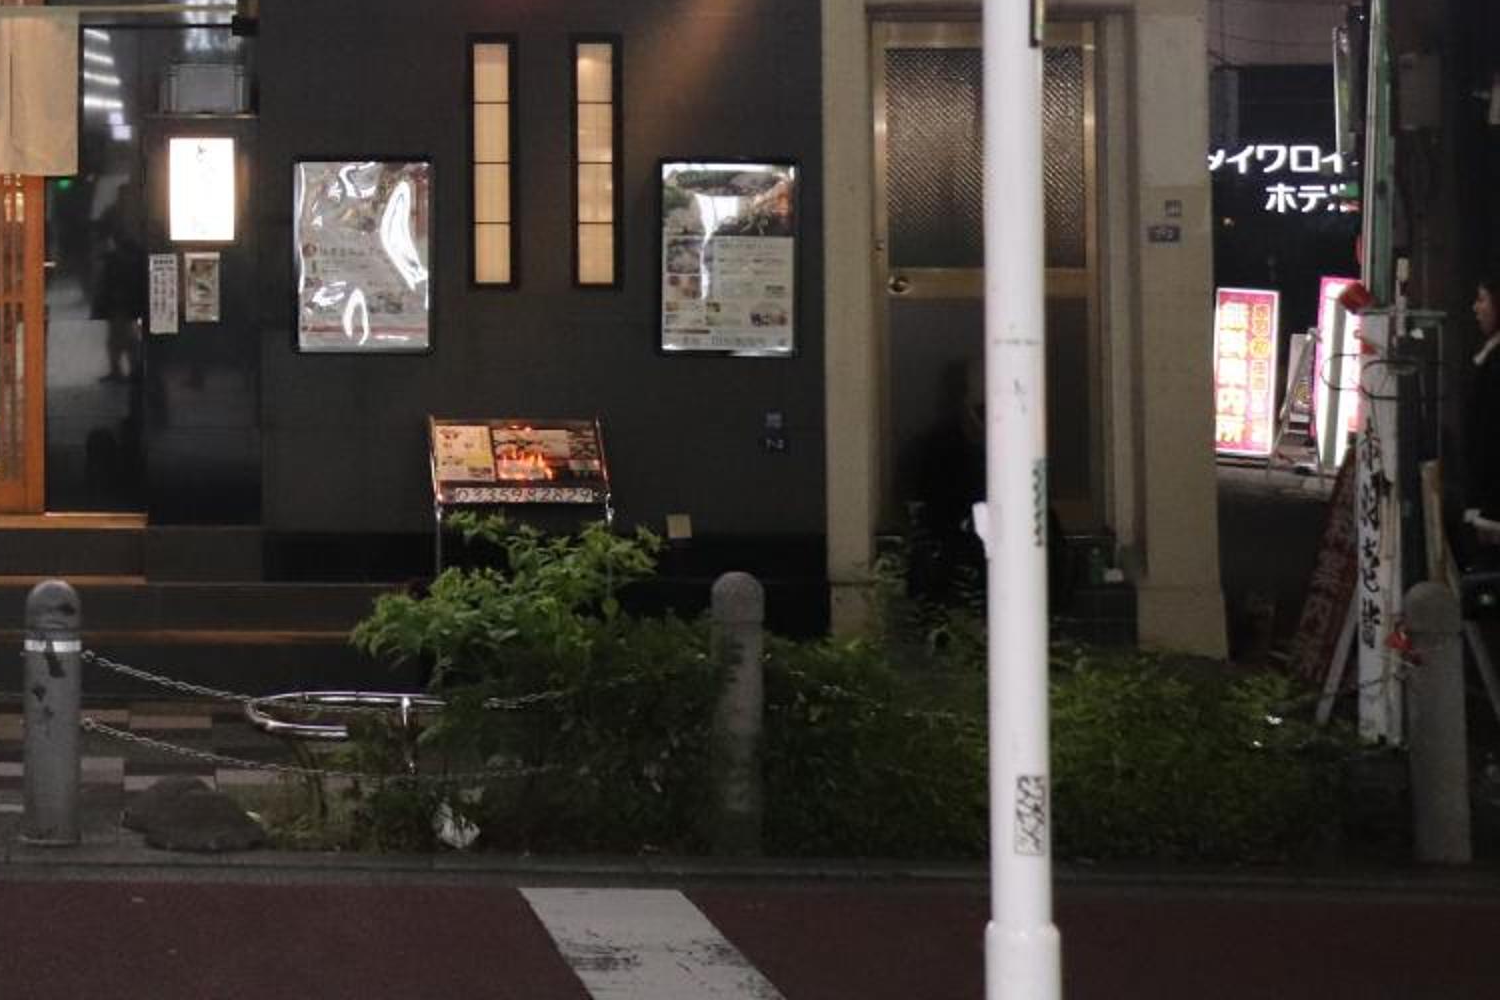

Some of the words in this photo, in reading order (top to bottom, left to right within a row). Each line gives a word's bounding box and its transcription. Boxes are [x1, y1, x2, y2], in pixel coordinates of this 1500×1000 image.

[1207, 143, 1359, 175] メイワロイ
